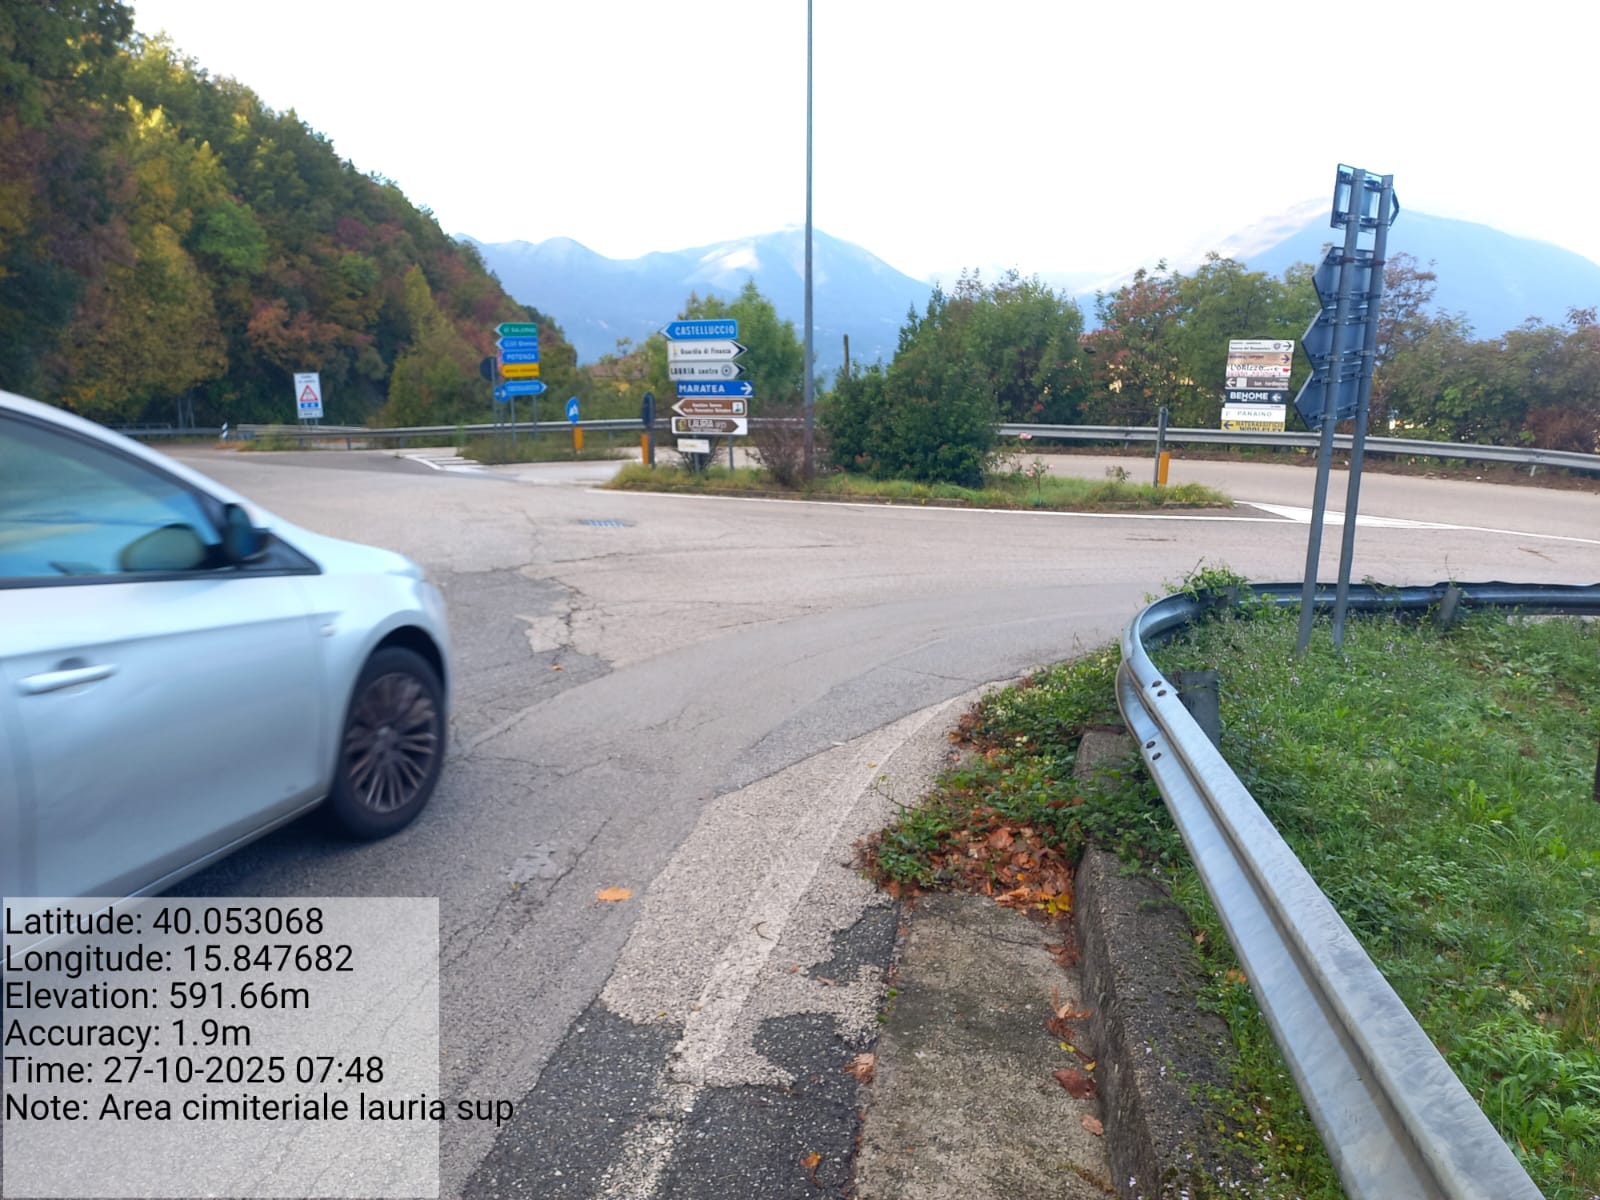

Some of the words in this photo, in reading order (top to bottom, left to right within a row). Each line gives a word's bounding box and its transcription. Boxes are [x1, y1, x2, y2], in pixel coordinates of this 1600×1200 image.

[674, 324, 735, 336] CASTELLUCCIO
[670, 367, 695, 375] LAURIA
[698, 367, 719, 375] centro
[678, 384, 726, 393] MARATEA
